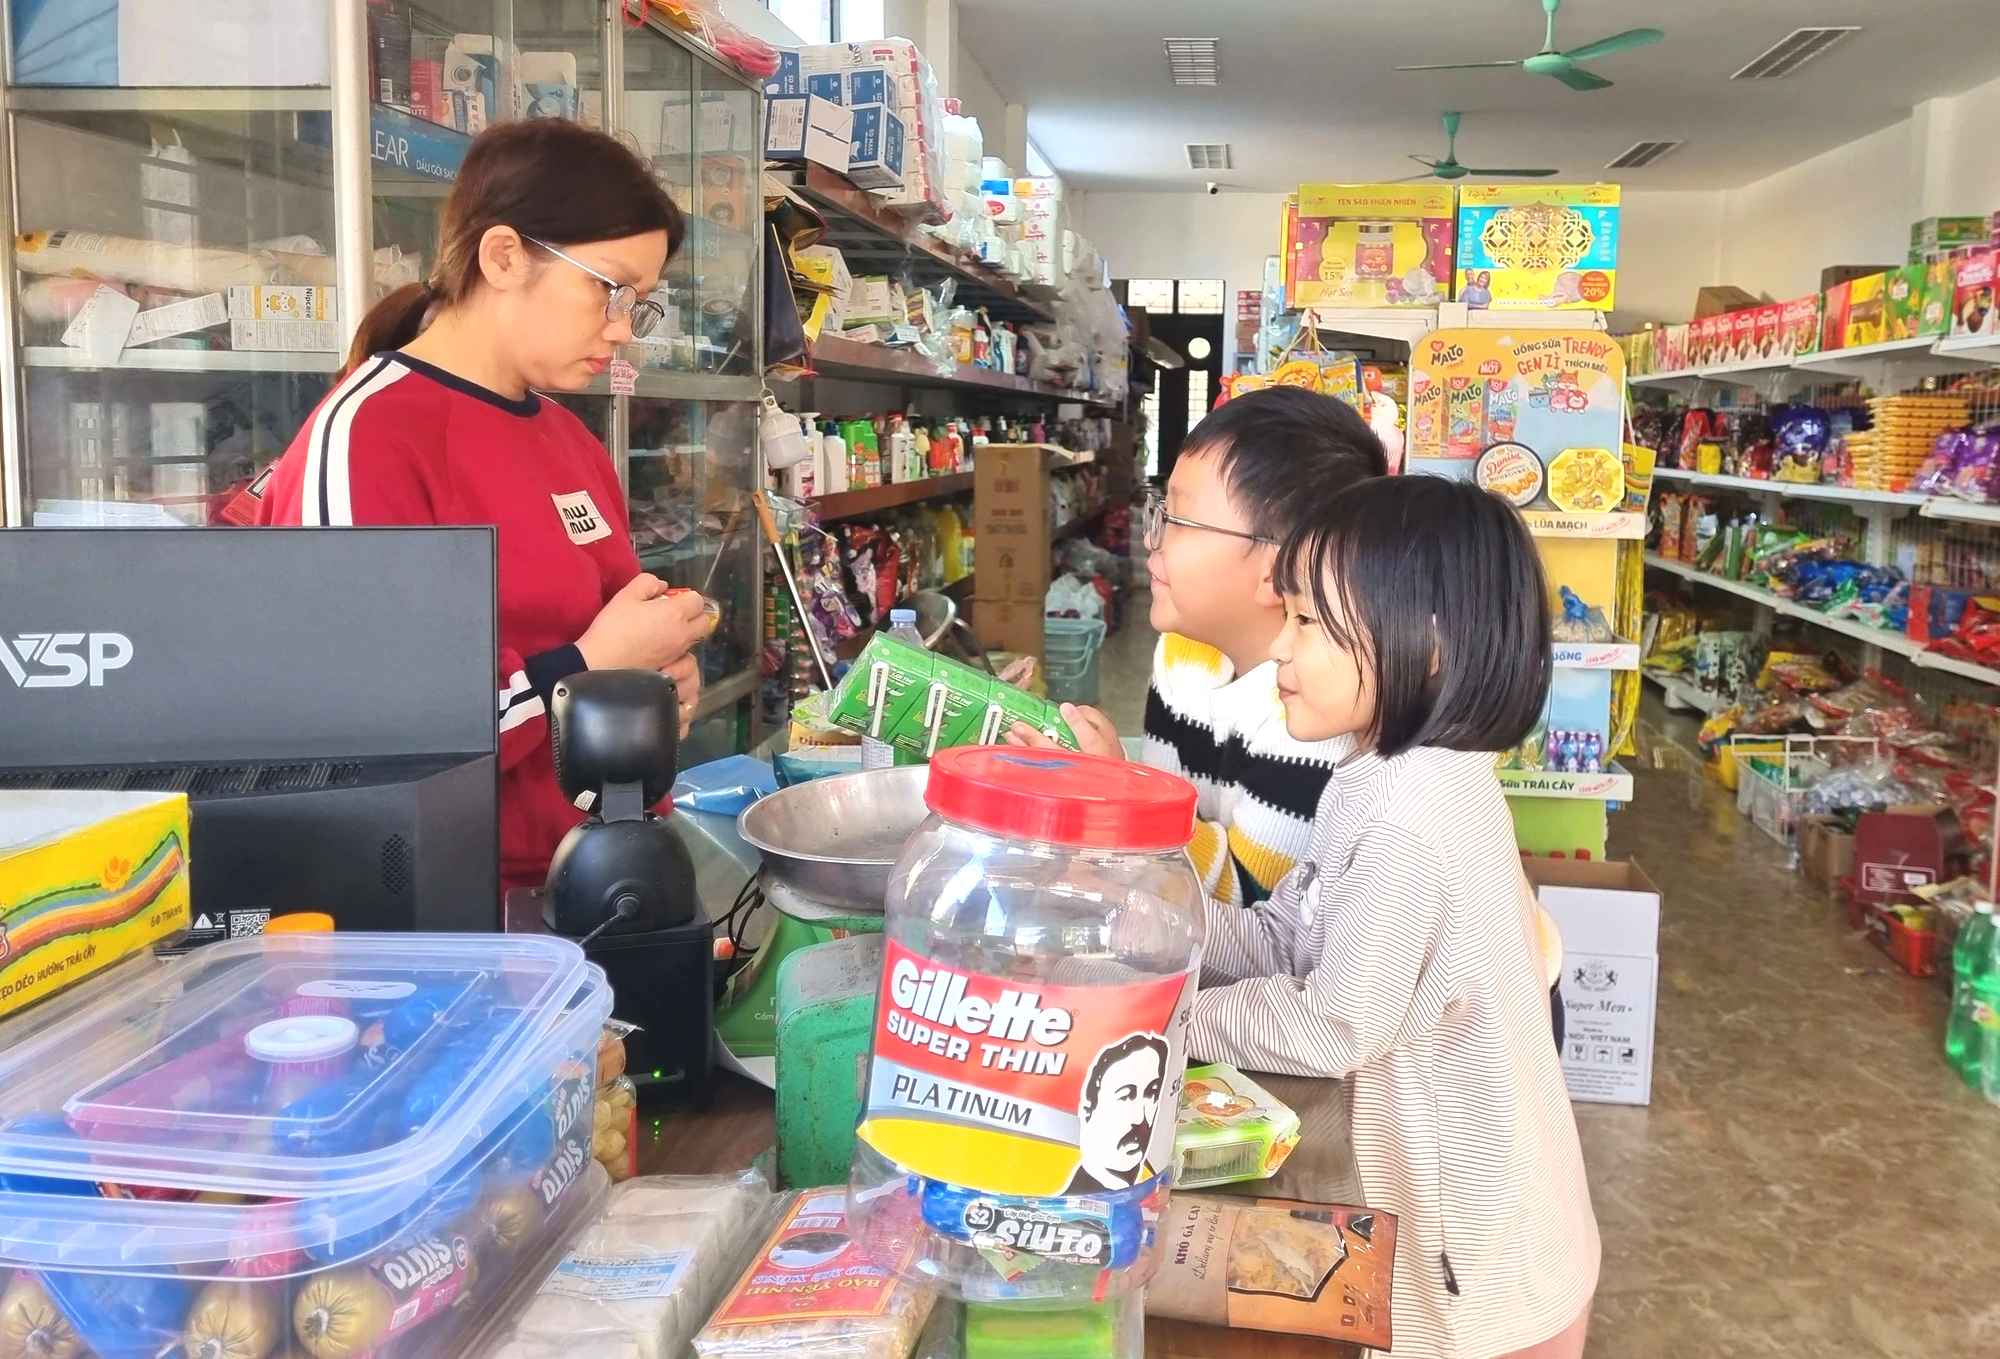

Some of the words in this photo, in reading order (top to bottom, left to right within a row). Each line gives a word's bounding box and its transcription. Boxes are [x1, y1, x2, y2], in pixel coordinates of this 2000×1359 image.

[371, 130, 409, 168] EAR
[1324, 271, 1344, 281] 15%
[1583, 287, 1606, 298] 20%
[305, 287, 313, 319] Nipcare
[1430, 344, 1464, 366] MALTO
[1563, 336, 1613, 360] TRENDY
[1517, 356, 1543, 375] GEN
[1414, 384, 1442, 407] MALTO
[1450, 383, 1482, 405] MALTO
[1489, 388, 1518, 406] MALTO
[1486, 452, 1523, 478] Danisa
[1534, 518, 1555, 529] LÚA
[1556, 520, 1588, 532] MẠCH
[1522, 778, 1545, 790] TRÁI
[1552, 779, 1574, 791] CÂY
[150, 914, 161, 927] 60
[15, 974, 35, 992] DẺO
[65, 951, 83, 969] TRÁI
[83, 944, 97, 961] CÂY
[891, 958, 1072, 1046] Gillette
[886, 1010, 971, 1063] SUPER
[979, 1043, 1068, 1076] THIN
[891, 1073, 1033, 1127] PLATINUM
[968, 1208, 990, 1226] S2
[1187, 1204, 1201, 1221] CAY
[1180, 1224, 1195, 1238] GÀ
[1174, 1241, 1190, 1265] KHÔ
[744, 1286, 785, 1296] NHI
[790, 1281, 831, 1296] YẾN
[838, 1278, 881, 1290] BẢO
